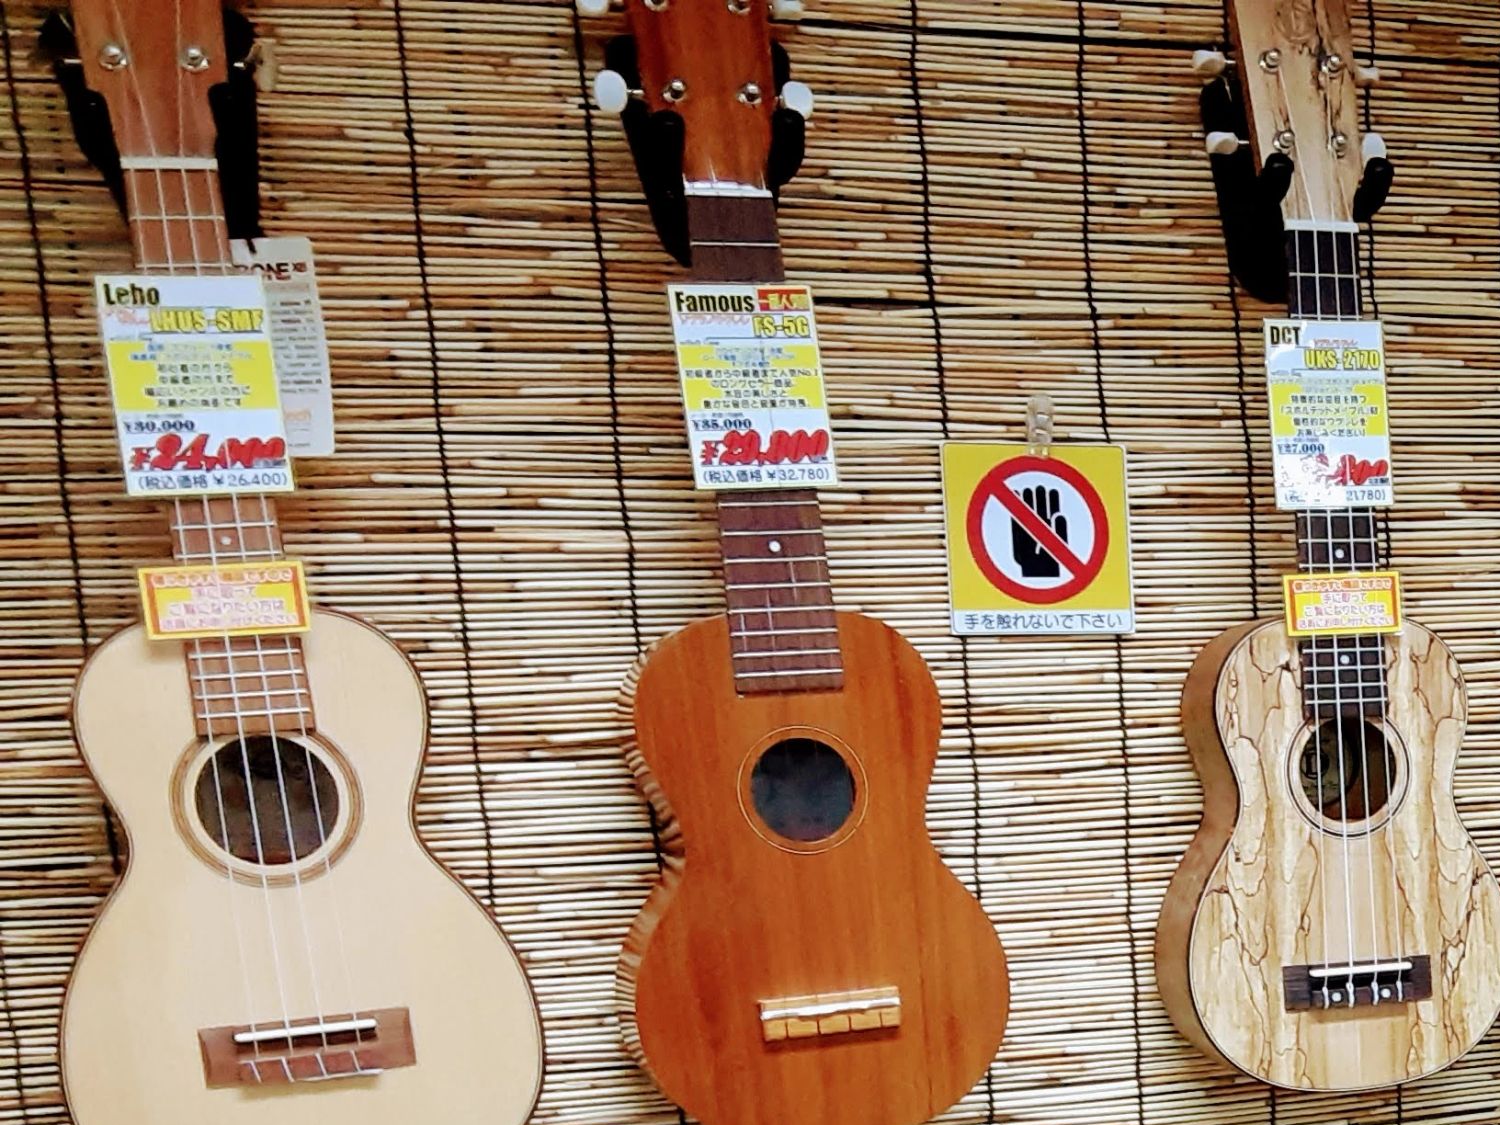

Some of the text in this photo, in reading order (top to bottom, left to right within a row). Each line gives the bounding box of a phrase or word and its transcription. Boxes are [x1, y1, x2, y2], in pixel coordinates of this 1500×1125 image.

[103, 283, 160, 305] Leho
[675, 291, 755, 312] Famous
[753, 316, 811, 337] FS-5G
[1270, 326, 1302, 346] DCT
[138, 475, 210, 489] (税込価格
[703, 470, 763, 485] (税込価格
[964, 613, 1123, 631] 手を触れないで下さい
